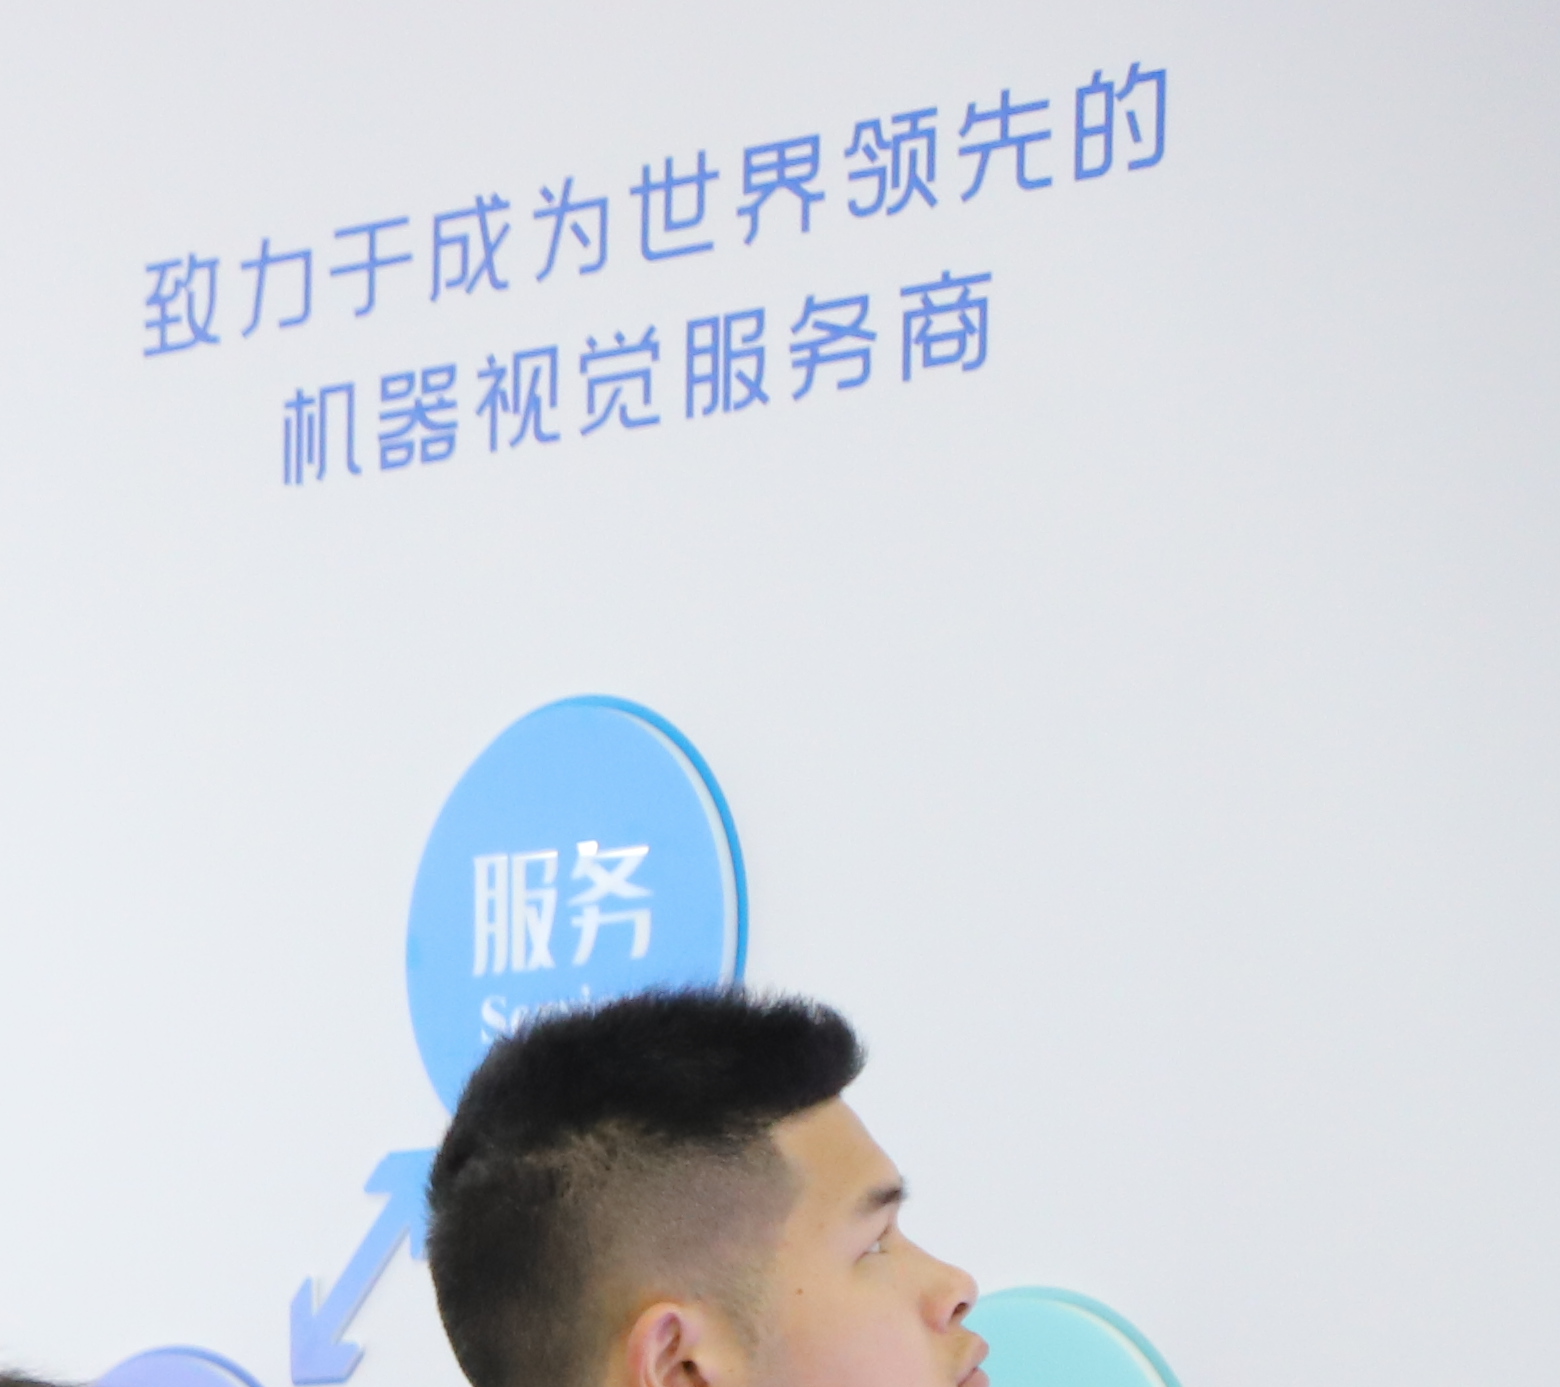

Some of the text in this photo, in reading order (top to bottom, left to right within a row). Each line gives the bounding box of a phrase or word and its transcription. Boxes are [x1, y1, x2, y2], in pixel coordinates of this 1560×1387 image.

[145, 62, 1167, 356] 致力于成为世界领先的
[285, 270, 992, 484] 机器视觉服务商
[472, 839, 654, 977] 服务
